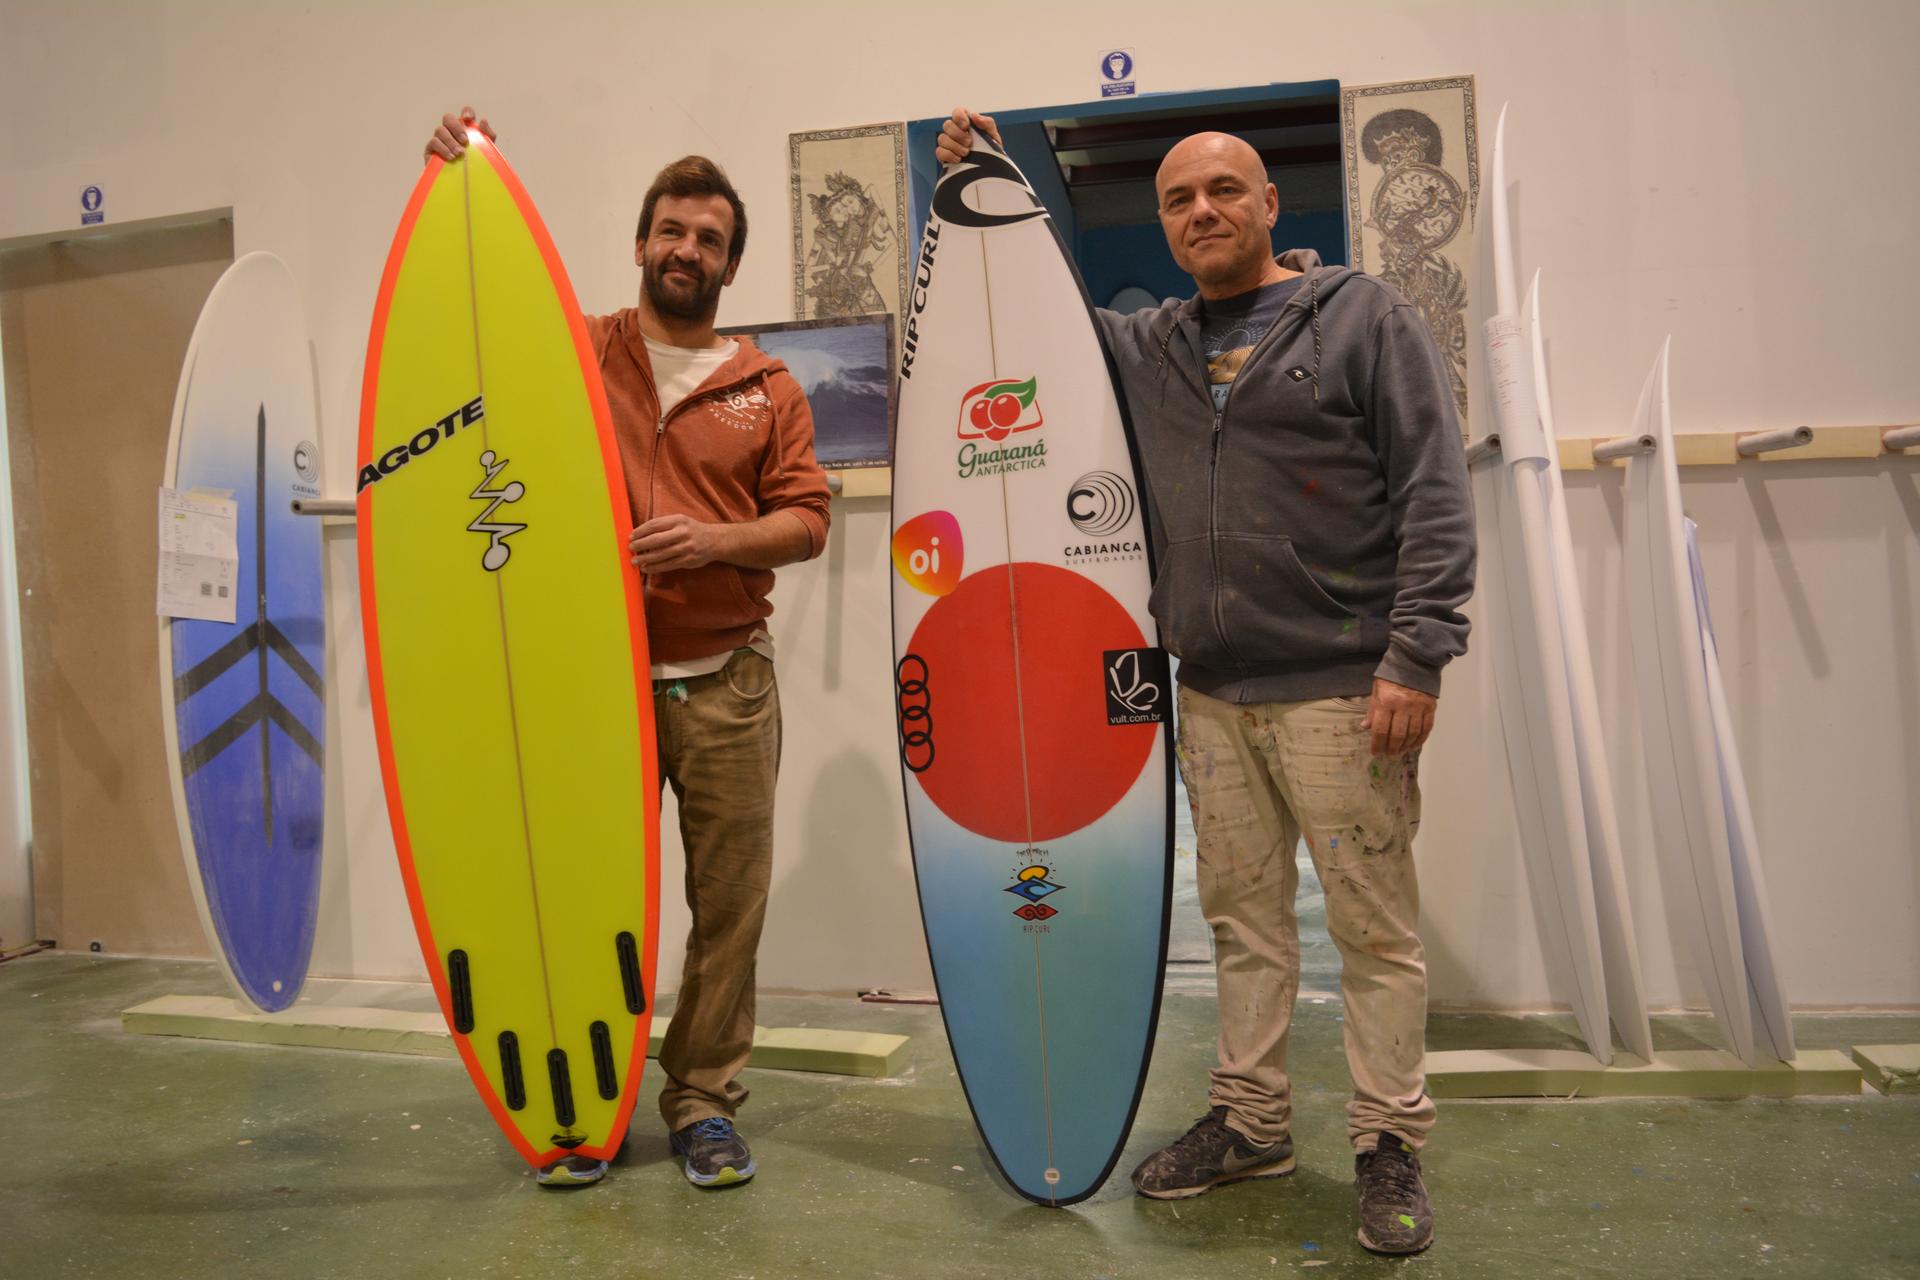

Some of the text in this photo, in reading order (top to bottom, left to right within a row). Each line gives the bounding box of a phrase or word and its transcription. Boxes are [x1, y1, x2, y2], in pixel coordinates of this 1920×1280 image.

[901, 223, 941, 379] RIP CURL
[357, 395, 484, 495] AGOTE
[958, 438, 1048, 478] Guaraná
[976, 458, 1046, 477] ANTARCTICA
[909, 536, 940, 575] oi
[1064, 542, 1142, 556] CABIANCA
[1065, 555, 1143, 565] SURFBOARDS
[1110, 713, 1161, 724] vult.com.br
